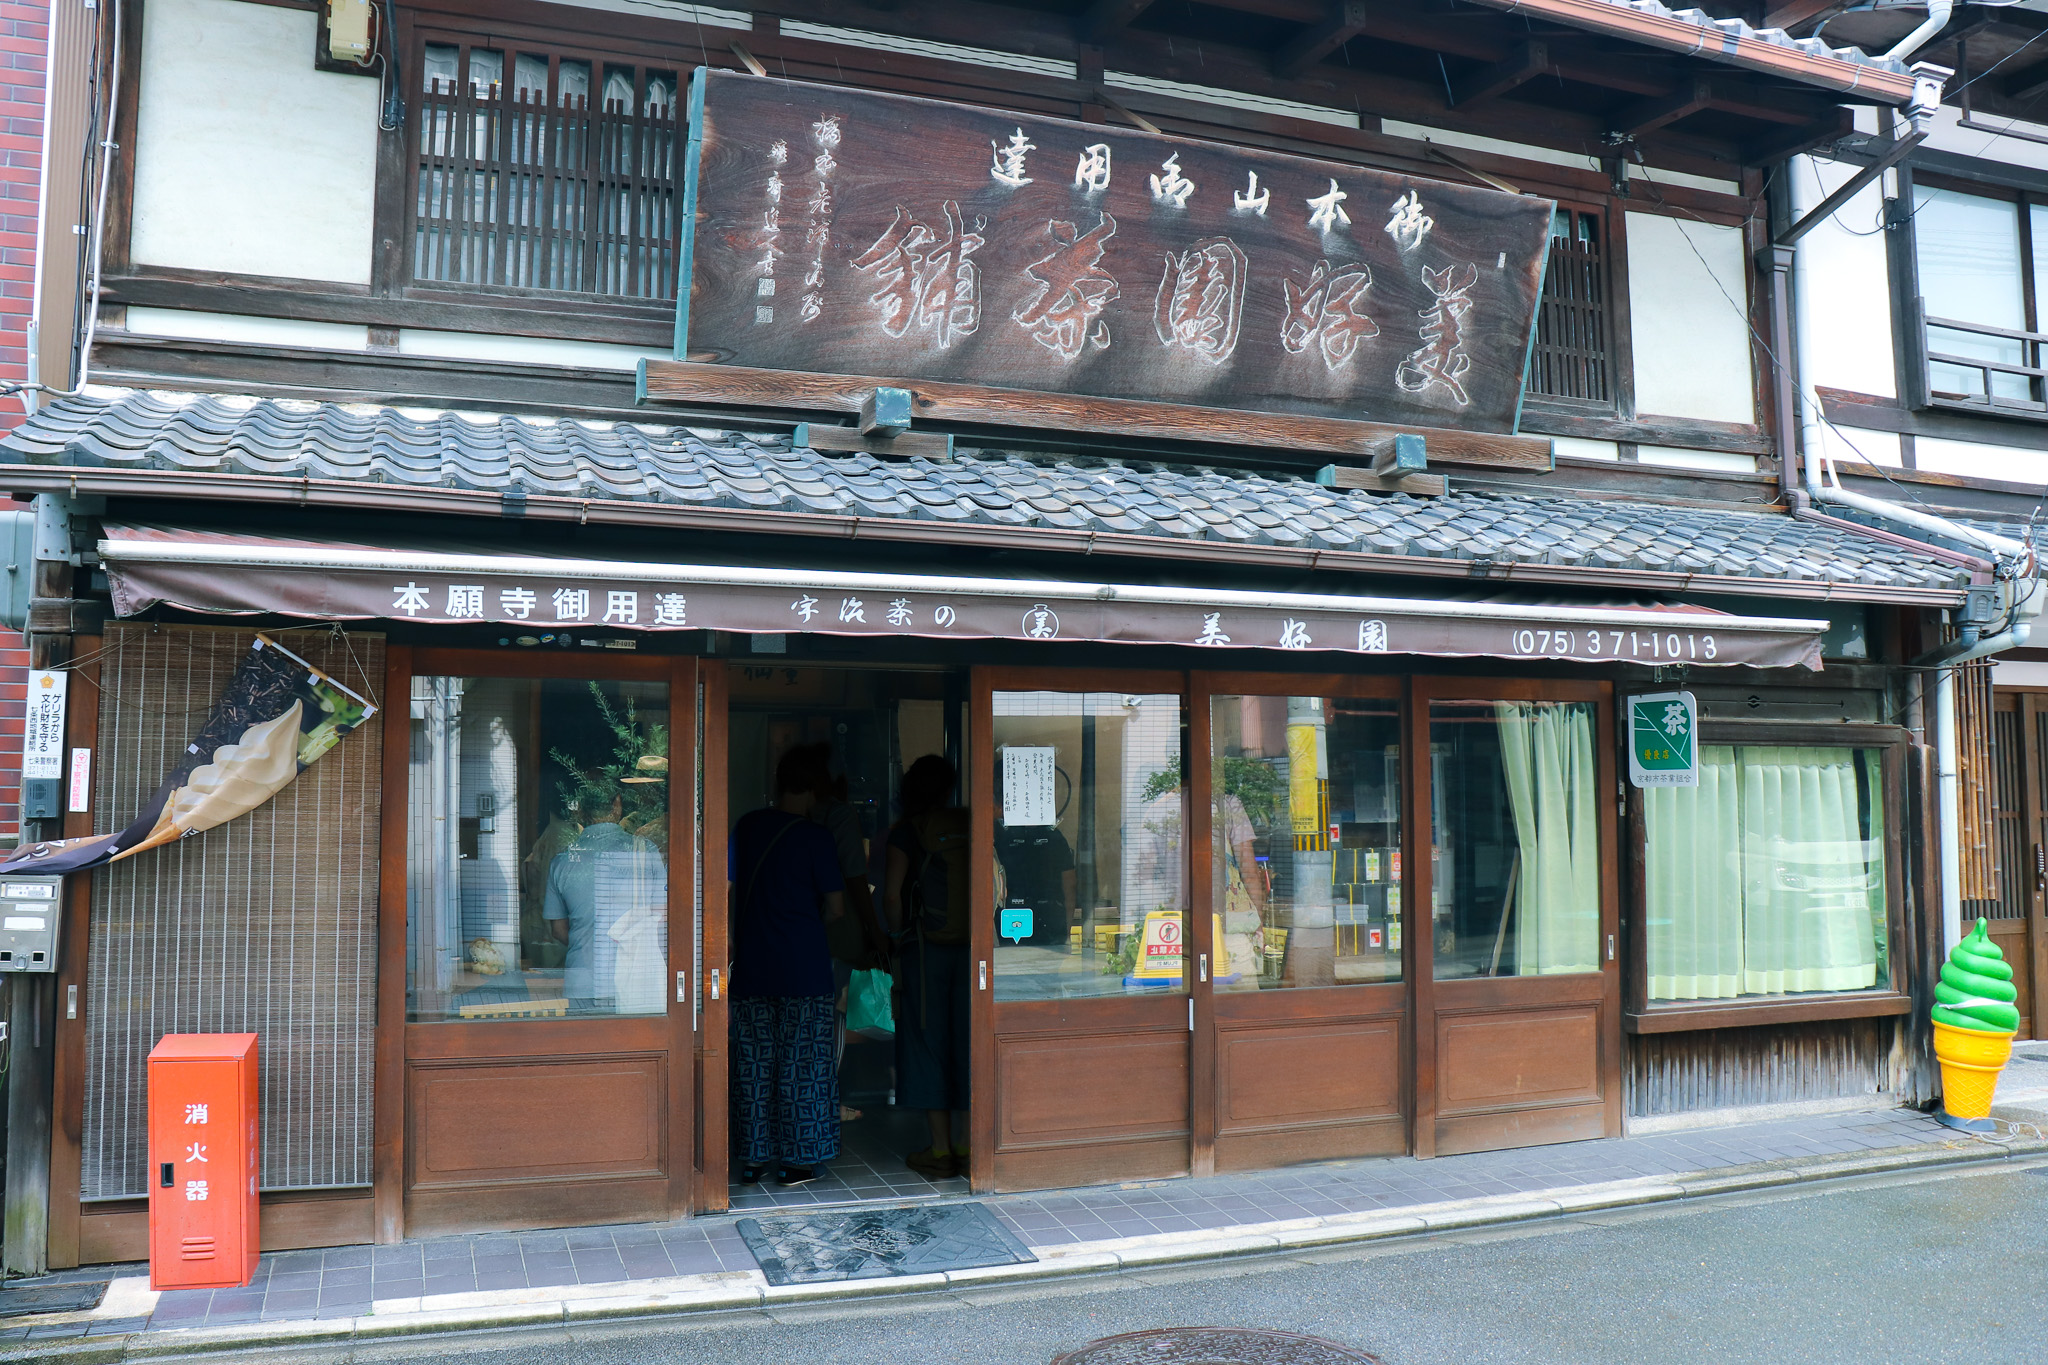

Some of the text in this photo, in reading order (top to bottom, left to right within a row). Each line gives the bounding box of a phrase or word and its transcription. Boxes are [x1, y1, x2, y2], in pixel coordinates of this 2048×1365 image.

[392, 581, 688, 626] 本願寺御用達
[790, 594, 957, 629] 宇治茶の
[1194, 611, 1389, 653] 美好園
[1511, 630, 1576, 655] (075)
[1586, 630, 1719, 660] 371-1013
[38, 693, 51, 752] 文化財を守る
[1660, 702, 1688, 736] 茶
[1636, 773, 1692, 783] 京都市茶業組合
[184, 1103, 209, 1202] 消火器
